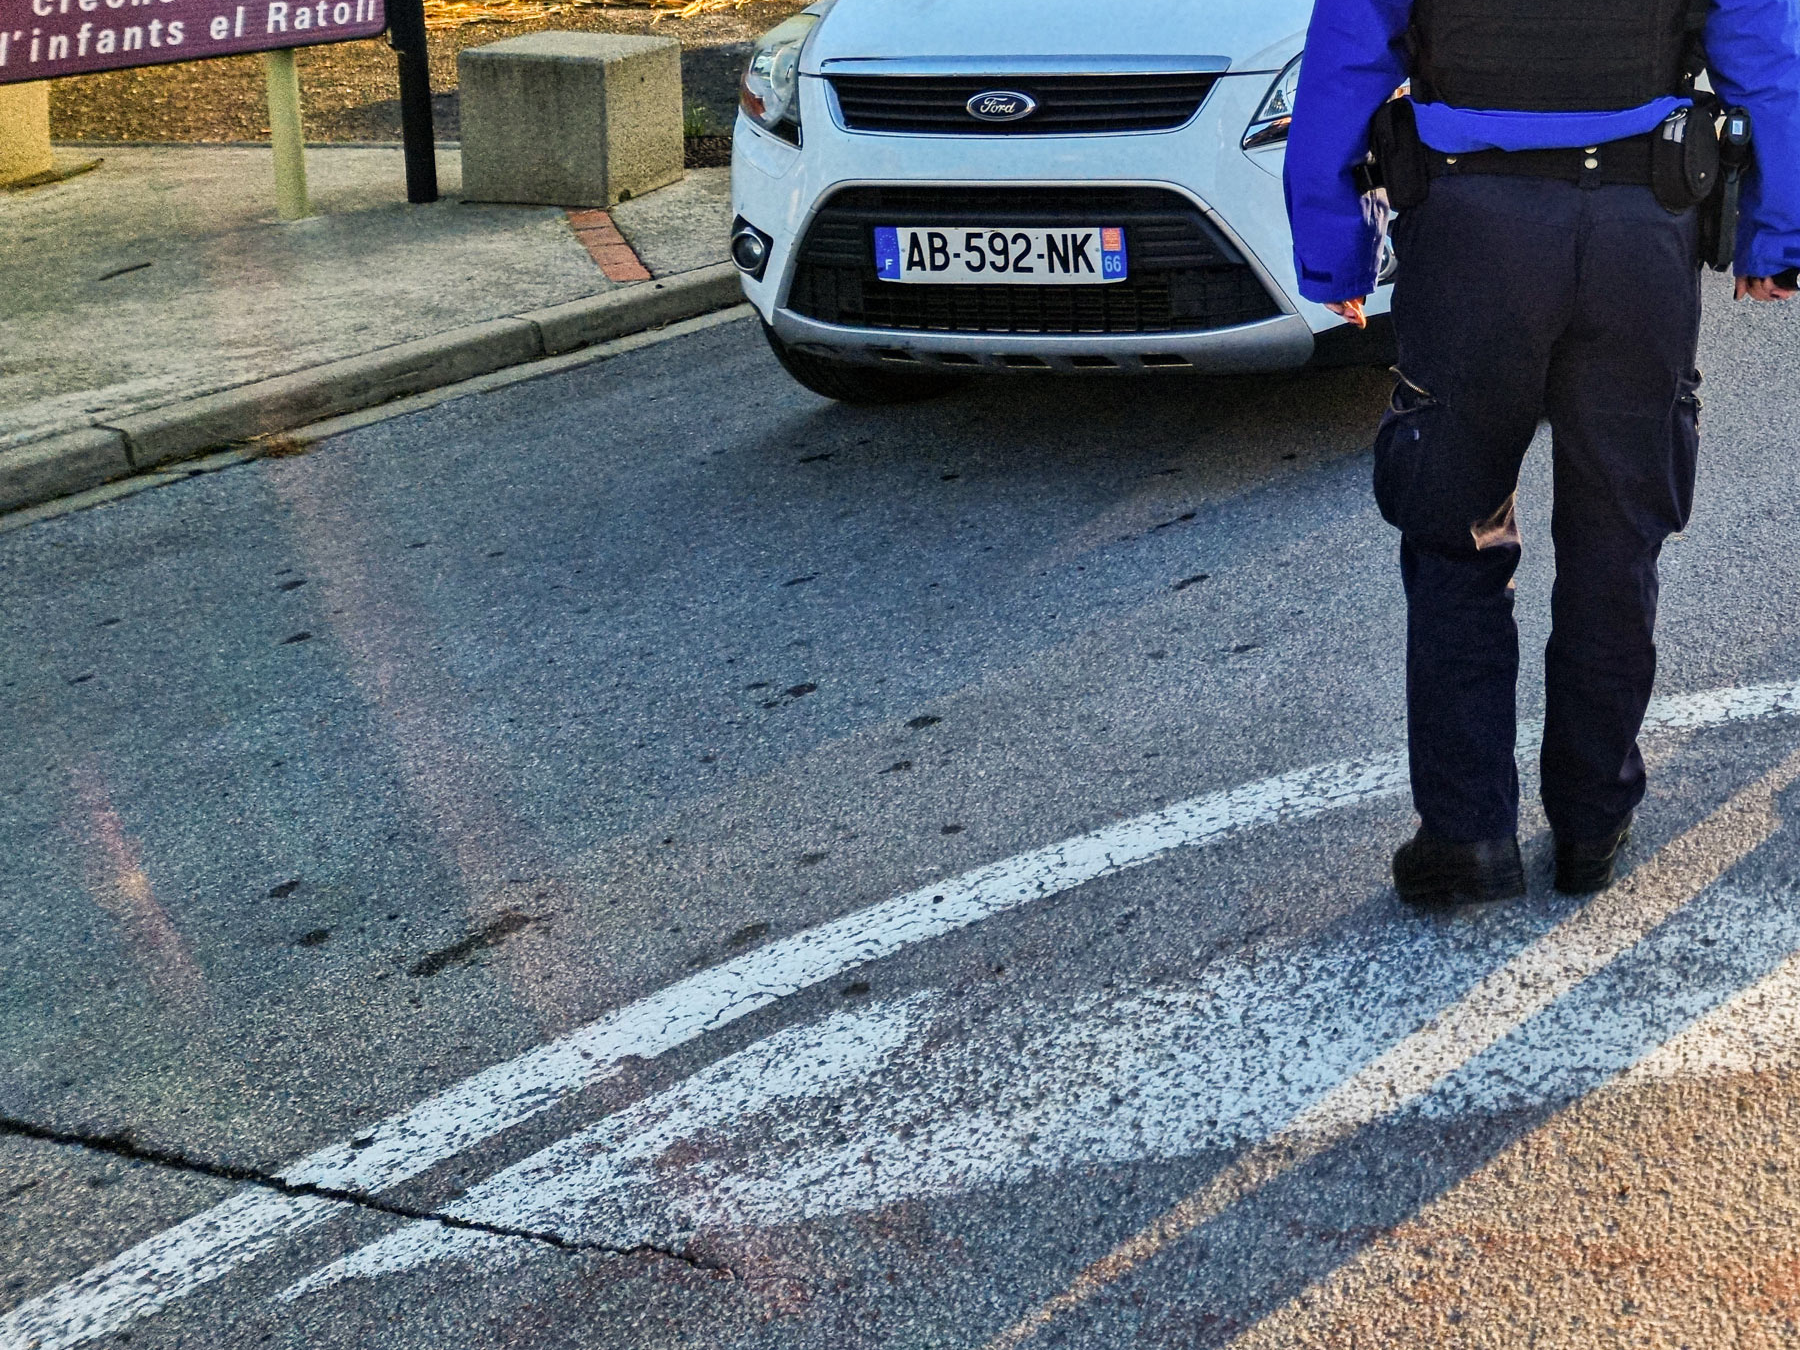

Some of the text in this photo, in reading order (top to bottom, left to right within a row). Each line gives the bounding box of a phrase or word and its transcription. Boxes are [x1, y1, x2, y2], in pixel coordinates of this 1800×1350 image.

[209, 5, 246, 40] el
[979, 96, 1017, 114] Ford
[885, 258, 894, 271] F
[905, 231, 1096, 274] AB-592-NK
[1103, 254, 1122, 273] 66
